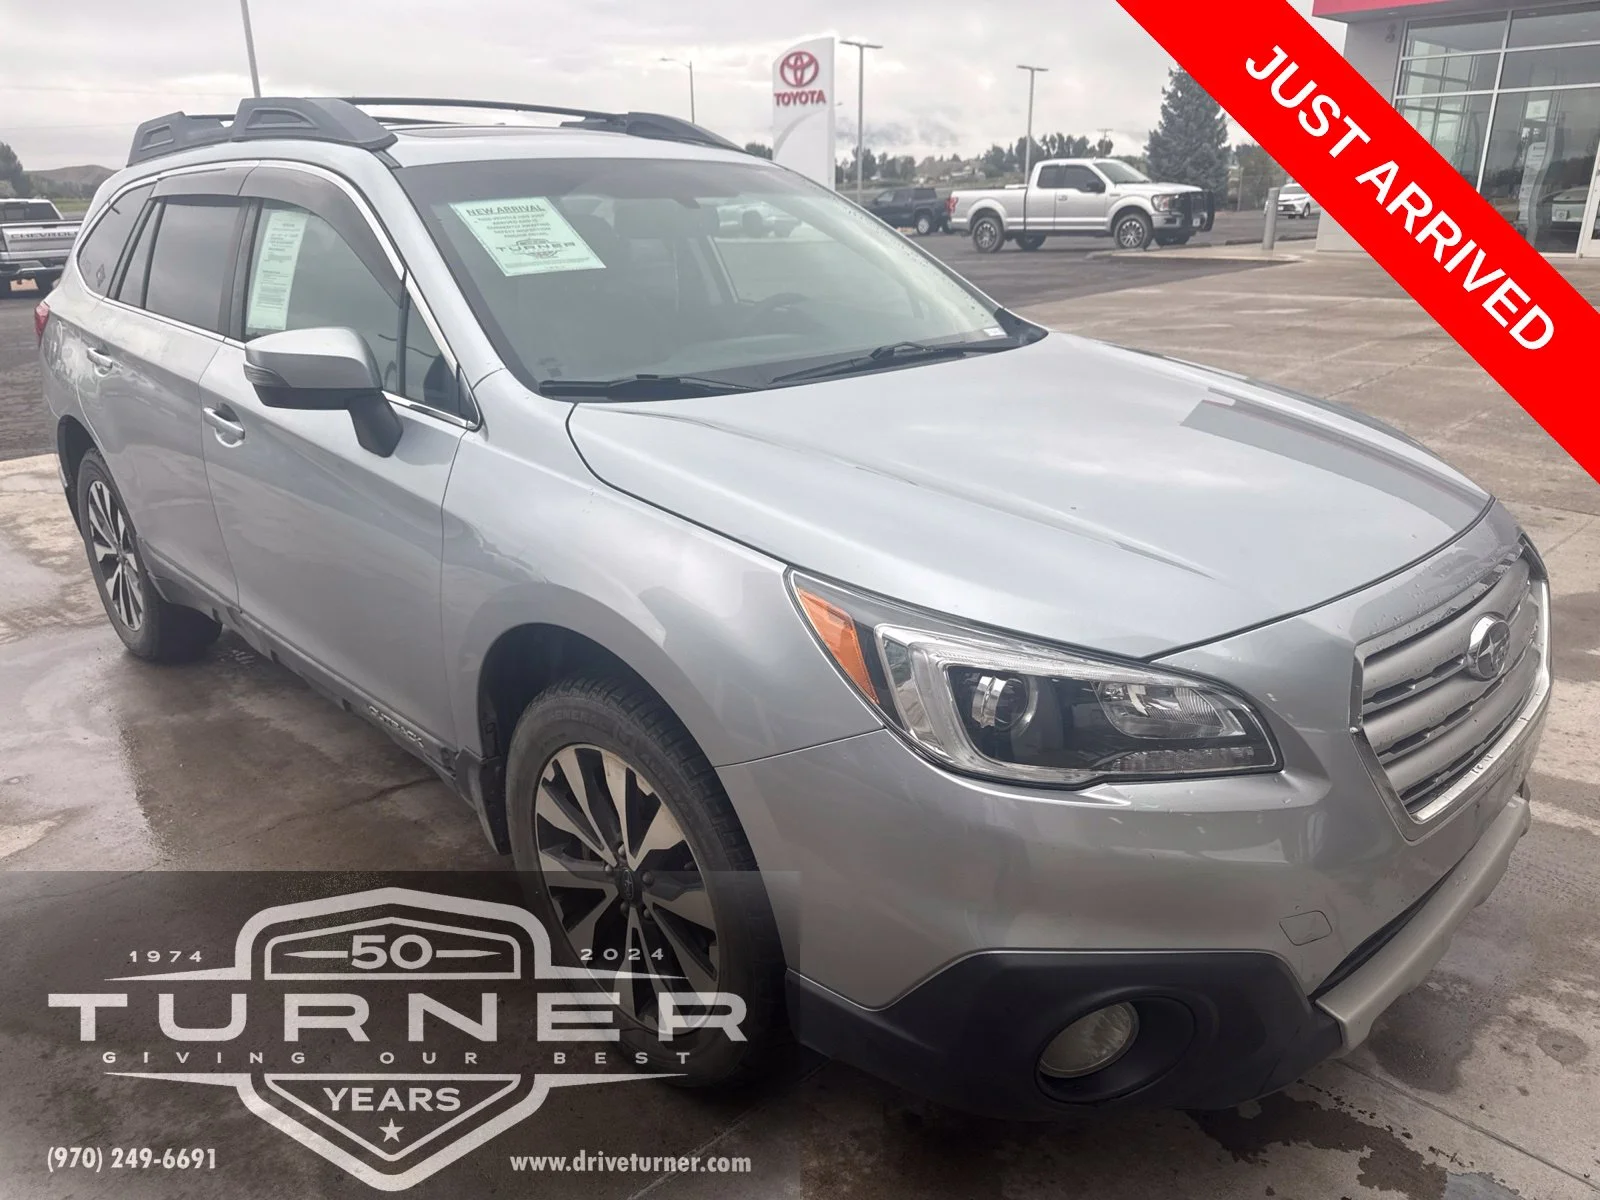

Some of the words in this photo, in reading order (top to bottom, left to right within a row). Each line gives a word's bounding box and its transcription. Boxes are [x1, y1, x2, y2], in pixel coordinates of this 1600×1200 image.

[773, 90, 827, 107] TOYOTA
[466, 207, 493, 216] NEW
[496, 205, 547, 214] ARRIVAL
[495, 241, 576, 252] TURNER
